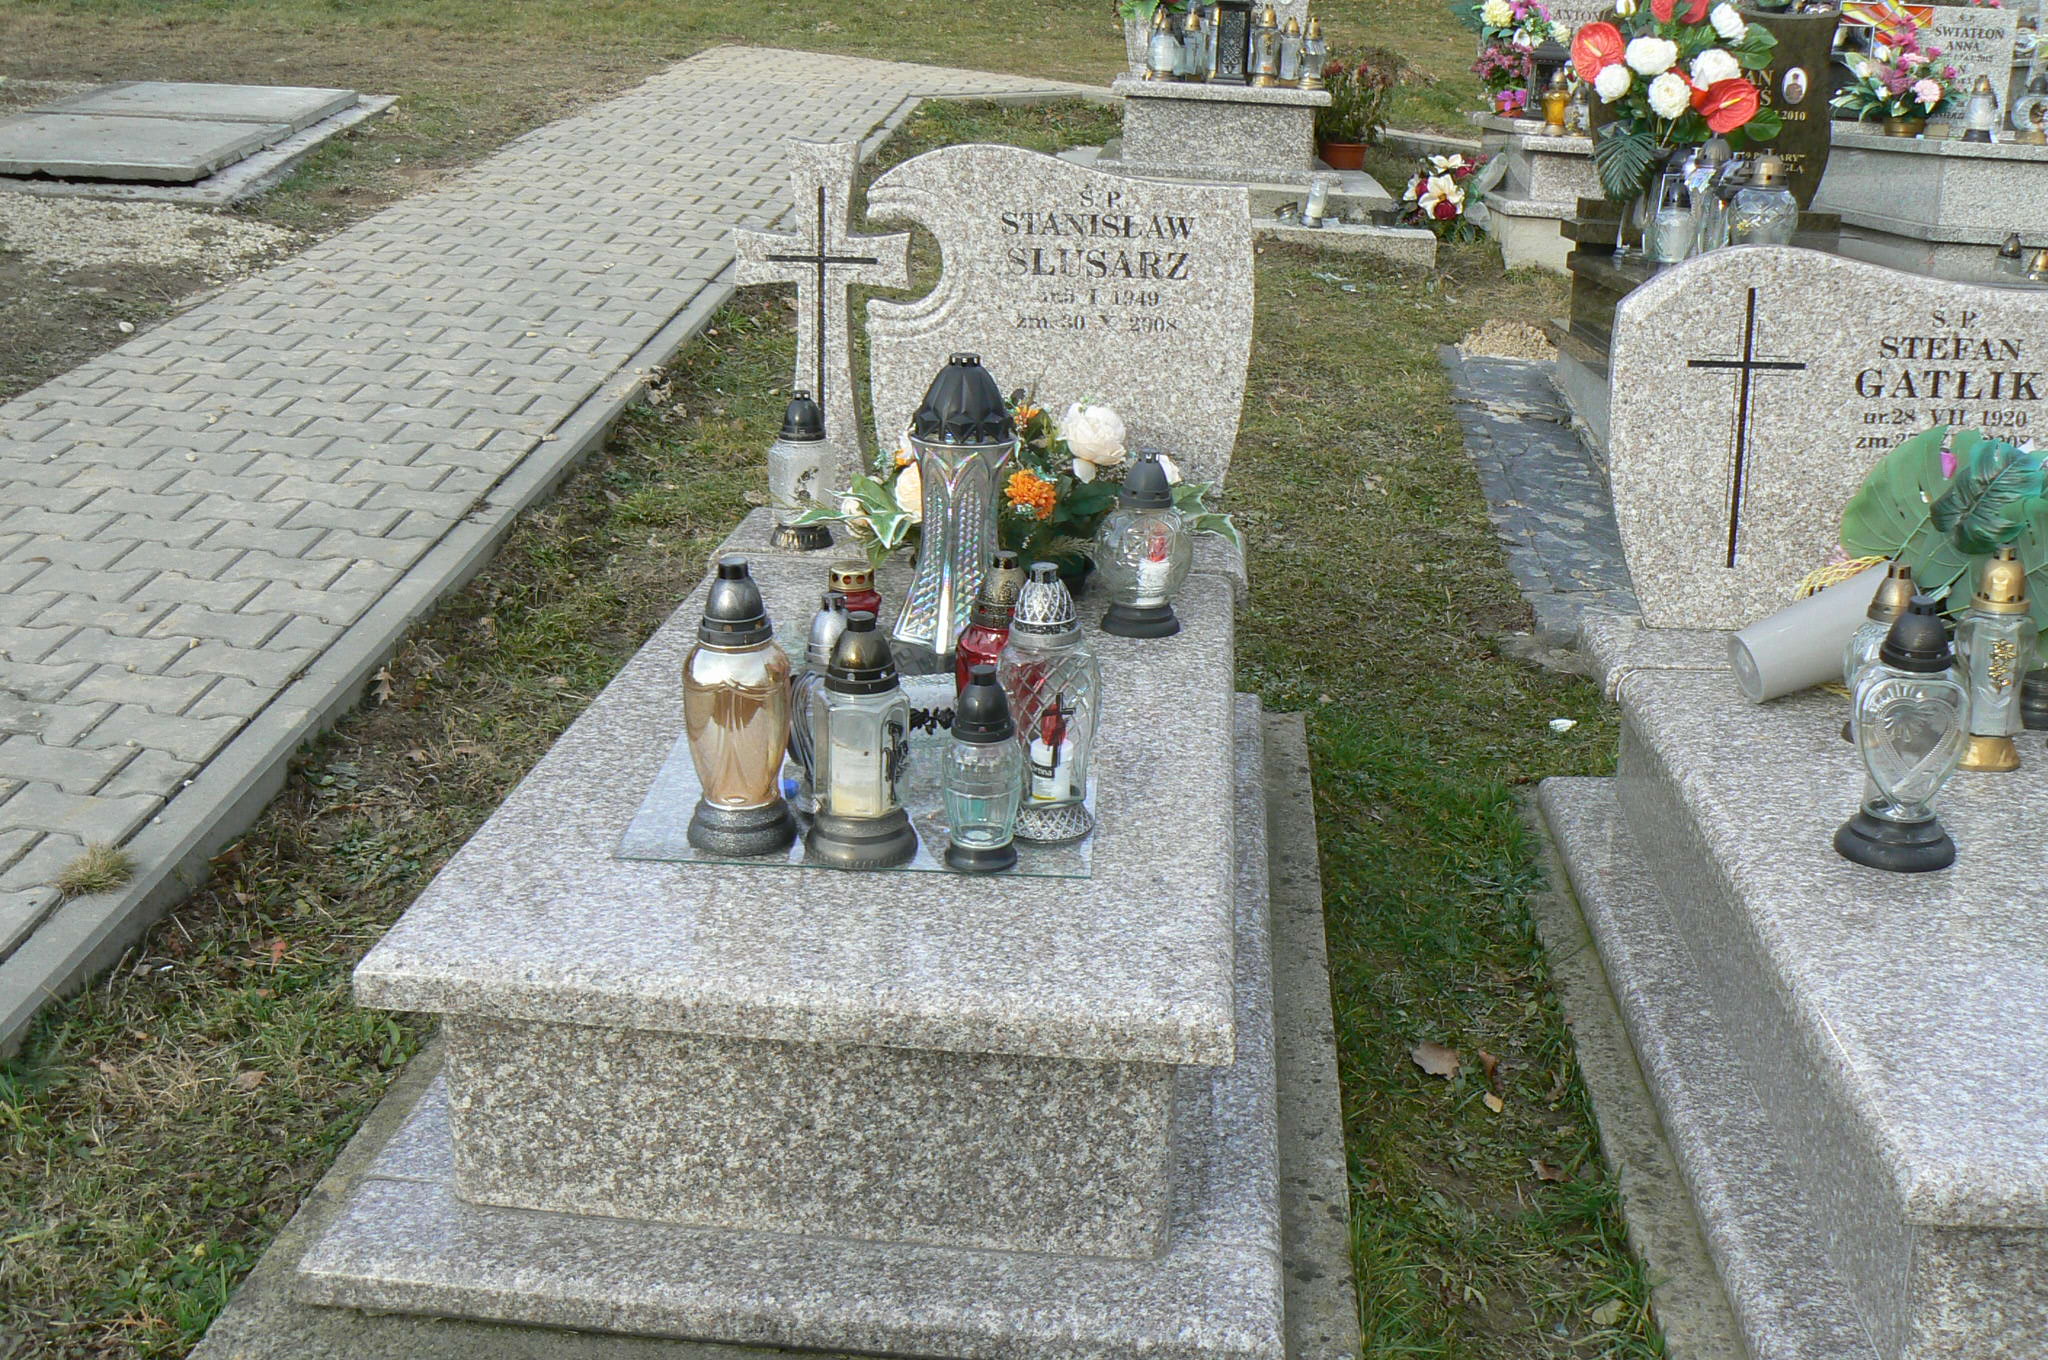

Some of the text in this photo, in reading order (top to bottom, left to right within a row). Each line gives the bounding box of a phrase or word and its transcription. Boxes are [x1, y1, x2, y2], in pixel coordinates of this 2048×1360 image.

[1945, 40, 1981, 52] ANNA
[1001, 211, 1196, 240] STANISŁAW
[1880, 335, 2026, 362] STEFAN
[1854, 367, 2043, 401] GATLIK
[1982, 410, 2028, 427] 1920
